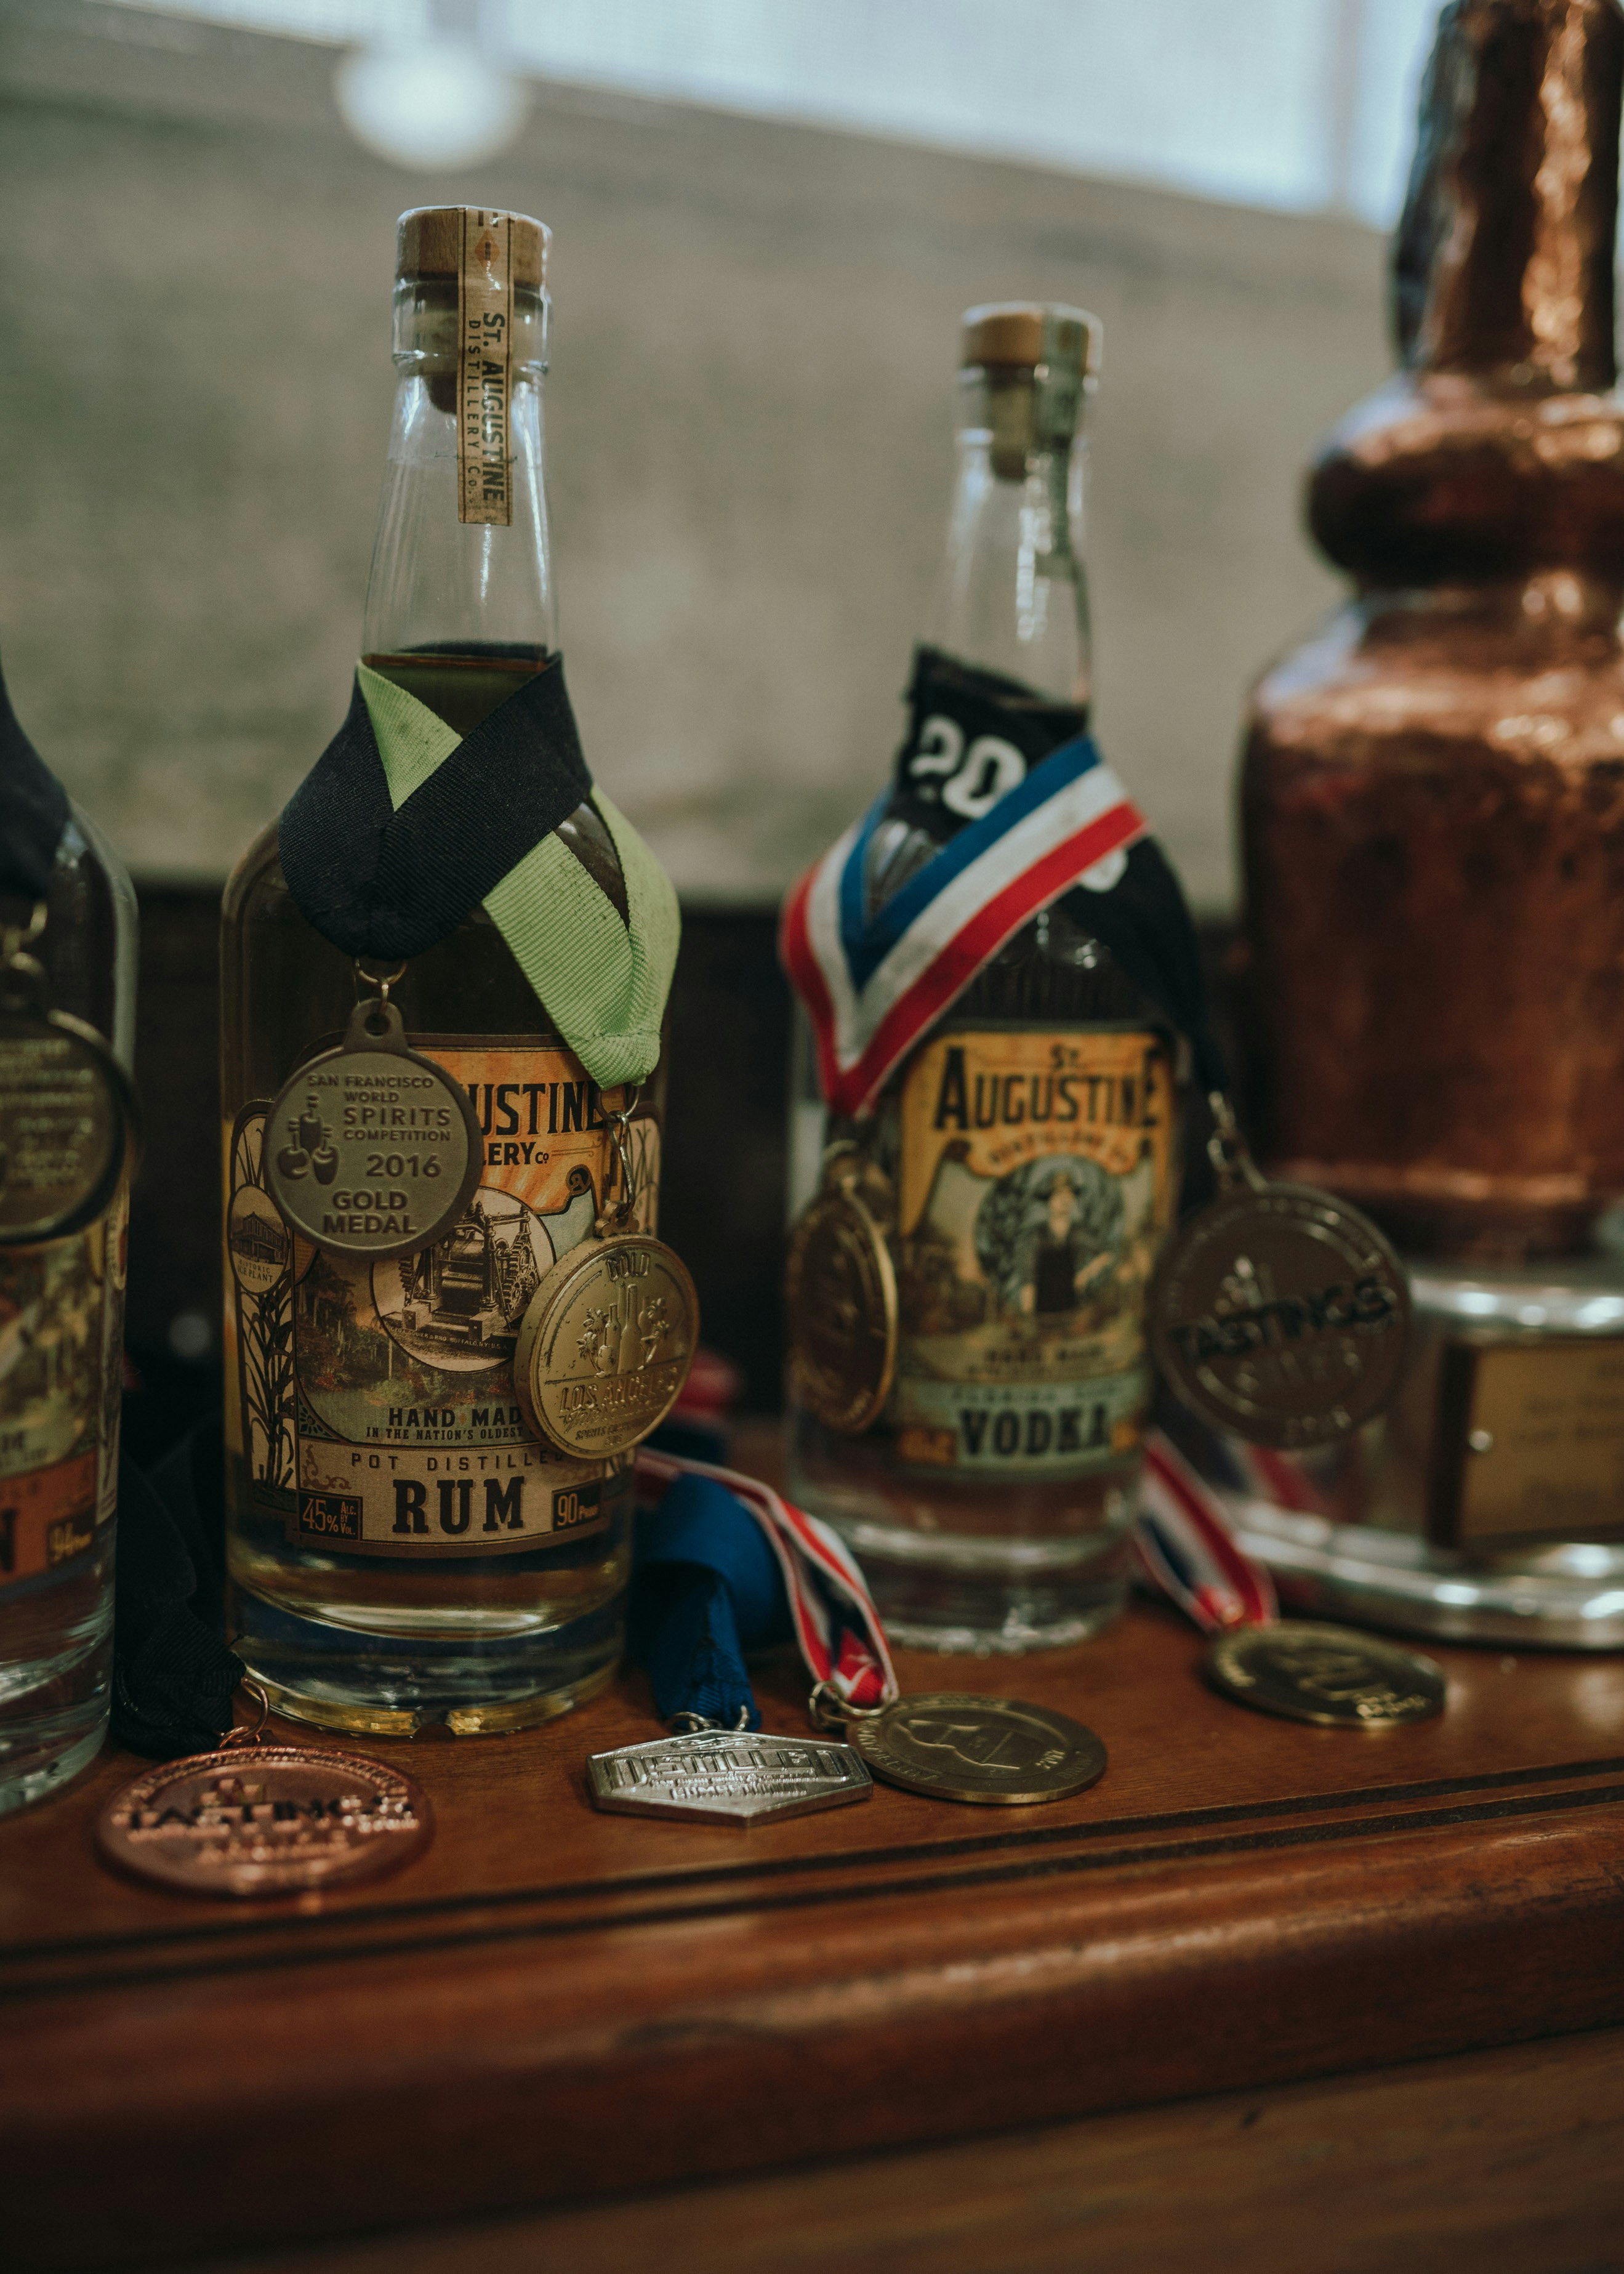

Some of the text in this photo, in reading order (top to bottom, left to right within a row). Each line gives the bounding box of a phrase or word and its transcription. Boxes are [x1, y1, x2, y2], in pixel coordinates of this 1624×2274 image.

[467, 320, 481, 448] DISTILLERY
[481, 312, 505, 502] ST. AUGUSTINE
[308, 1073, 434, 1088] SAN FRANCISCO
[933, 1046, 1159, 1131] AUGUSTINE
[344, 1090, 400, 1102] WORLD
[467, 1080, 604, 1135] USTINE
[344, 1105, 451, 1126] SPIRITS
[344, 1128, 451, 1141] COMPETITION
[366, 1151, 442, 1179] 2016
[333, 1188, 409, 1210] GOLD
[324, 1212, 417, 1234] MEDAL
[248, 1269, 273, 1283] PLANT
[560, 1383, 598, 1413] LOS
[388, 1406, 522, 1427] HAND MAD
[366, 1427, 379, 1438] IN
[385, 1428, 409, 1439] THE
[416, 1429, 473, 1440] NATION'S
[480, 1427, 523, 1439] OLDEST
[959, 1401, 1109, 1458] VODKA
[352, 1453, 398, 1470] POT
[302, 1498, 339, 1533] 45%
[392, 1476, 525, 1535] RUM
[556, 1493, 578, 1527] 90
